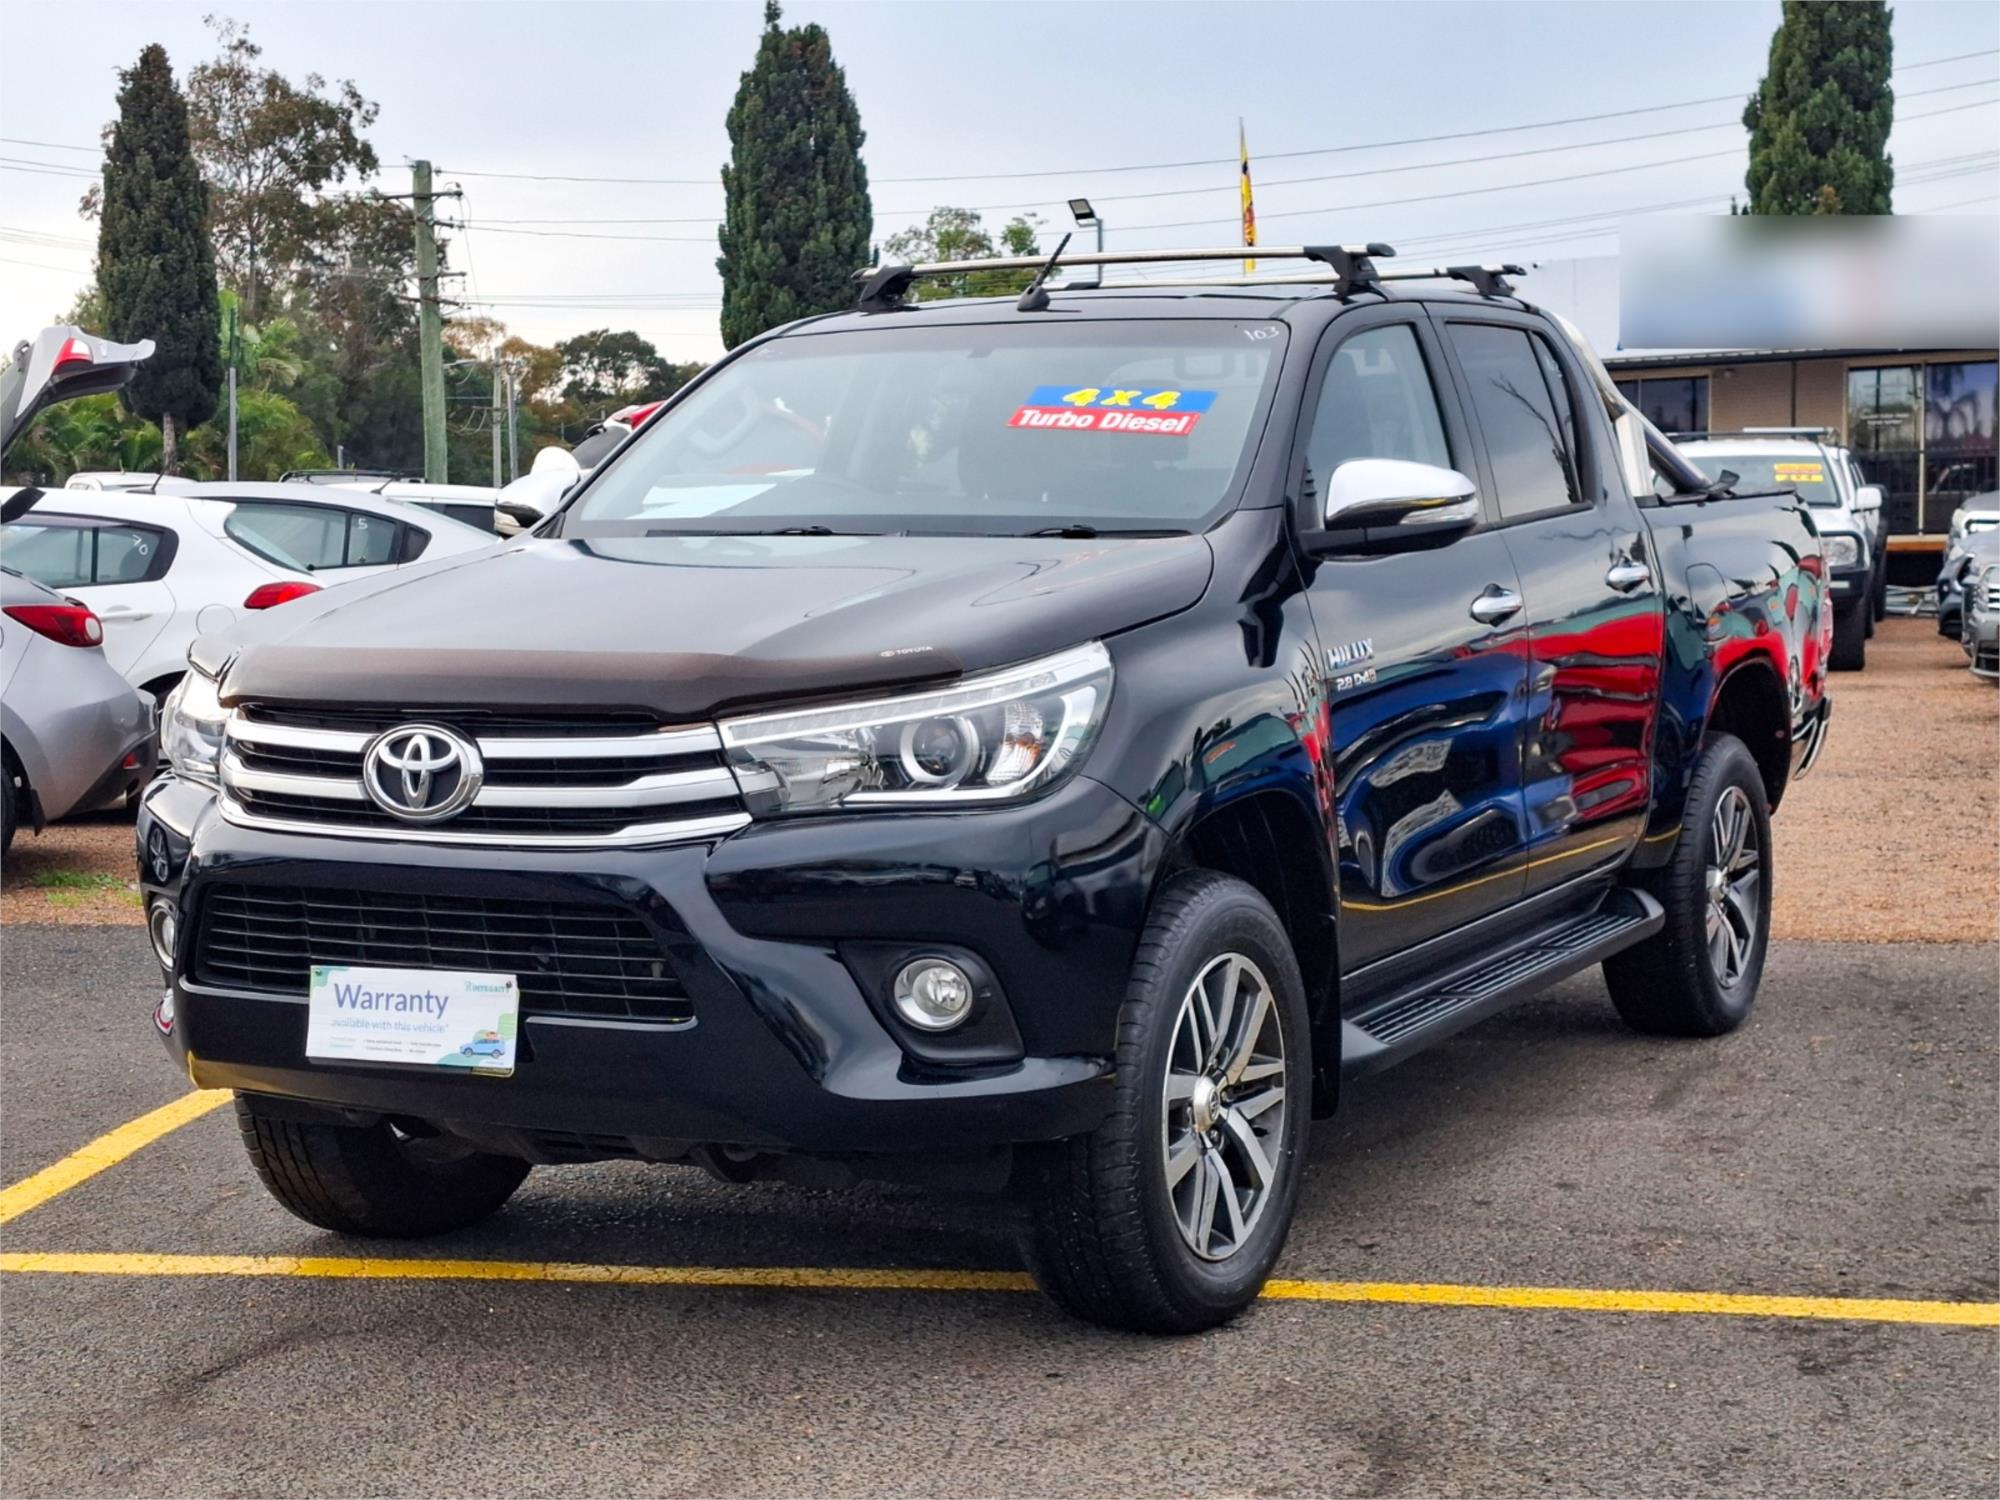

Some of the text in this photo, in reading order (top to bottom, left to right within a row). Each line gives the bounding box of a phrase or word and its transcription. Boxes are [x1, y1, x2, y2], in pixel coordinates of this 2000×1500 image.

[1243, 326, 1279, 340] 103
[1018, 409, 1190, 431] Turbo Diesel
[896, 646, 934, 655] TOYOTA
[1327, 638, 1373, 669] HILUX
[334, 983, 449, 1020] Warranty
[330, 1016, 370, 1029] available
[372, 1018, 392, 1031] with
[394, 1020, 411, 1032] this
